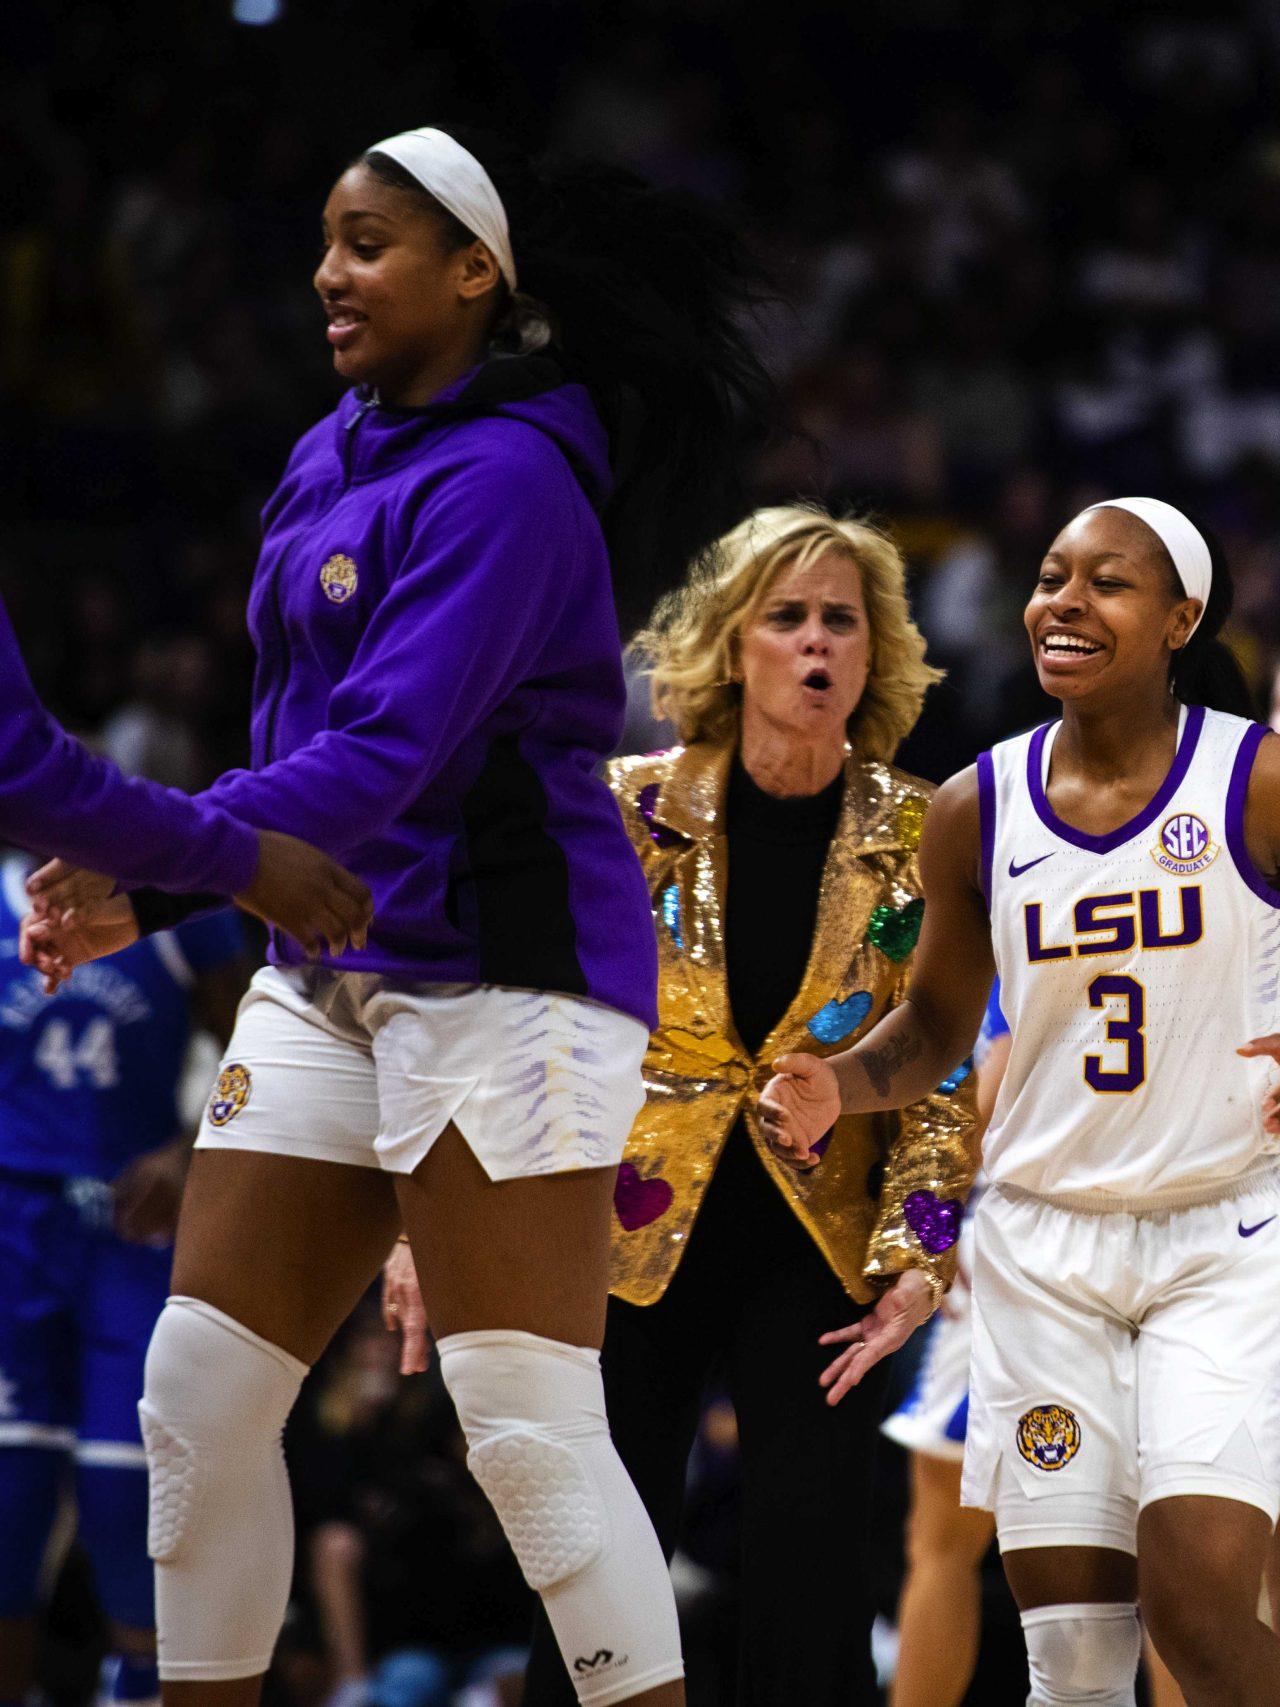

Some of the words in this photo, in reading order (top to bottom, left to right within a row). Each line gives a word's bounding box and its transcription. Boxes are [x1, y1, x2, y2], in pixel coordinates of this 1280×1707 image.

[1158, 855, 1212, 873] GRADUATE
[1163, 815, 1206, 859] SEC
[1024, 885, 1204, 965] LSU
[33, 1014, 121, 1091] 44
[1083, 972, 1146, 1094] 3
